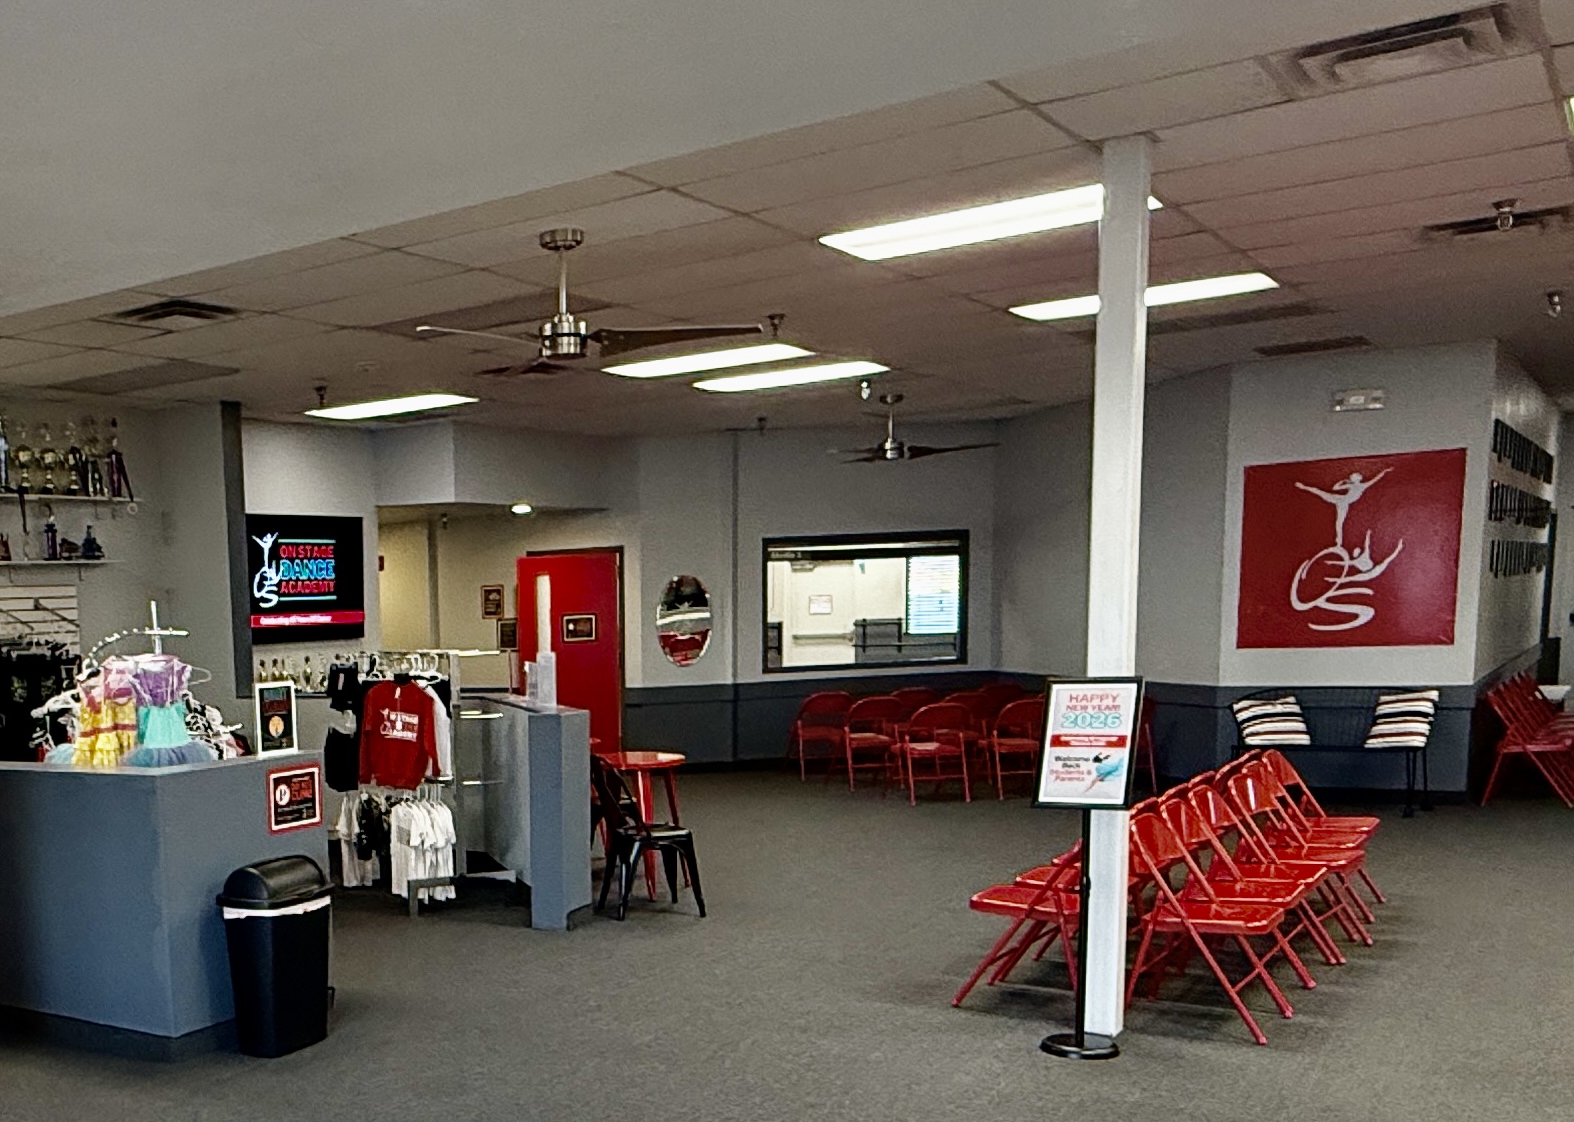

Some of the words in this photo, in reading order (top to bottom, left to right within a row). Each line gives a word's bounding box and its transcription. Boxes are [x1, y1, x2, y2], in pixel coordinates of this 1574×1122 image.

[279, 559, 336, 580] DANCE
[1068, 692, 1120, 704] HAPPY
[1060, 712, 1123, 729] 2026
